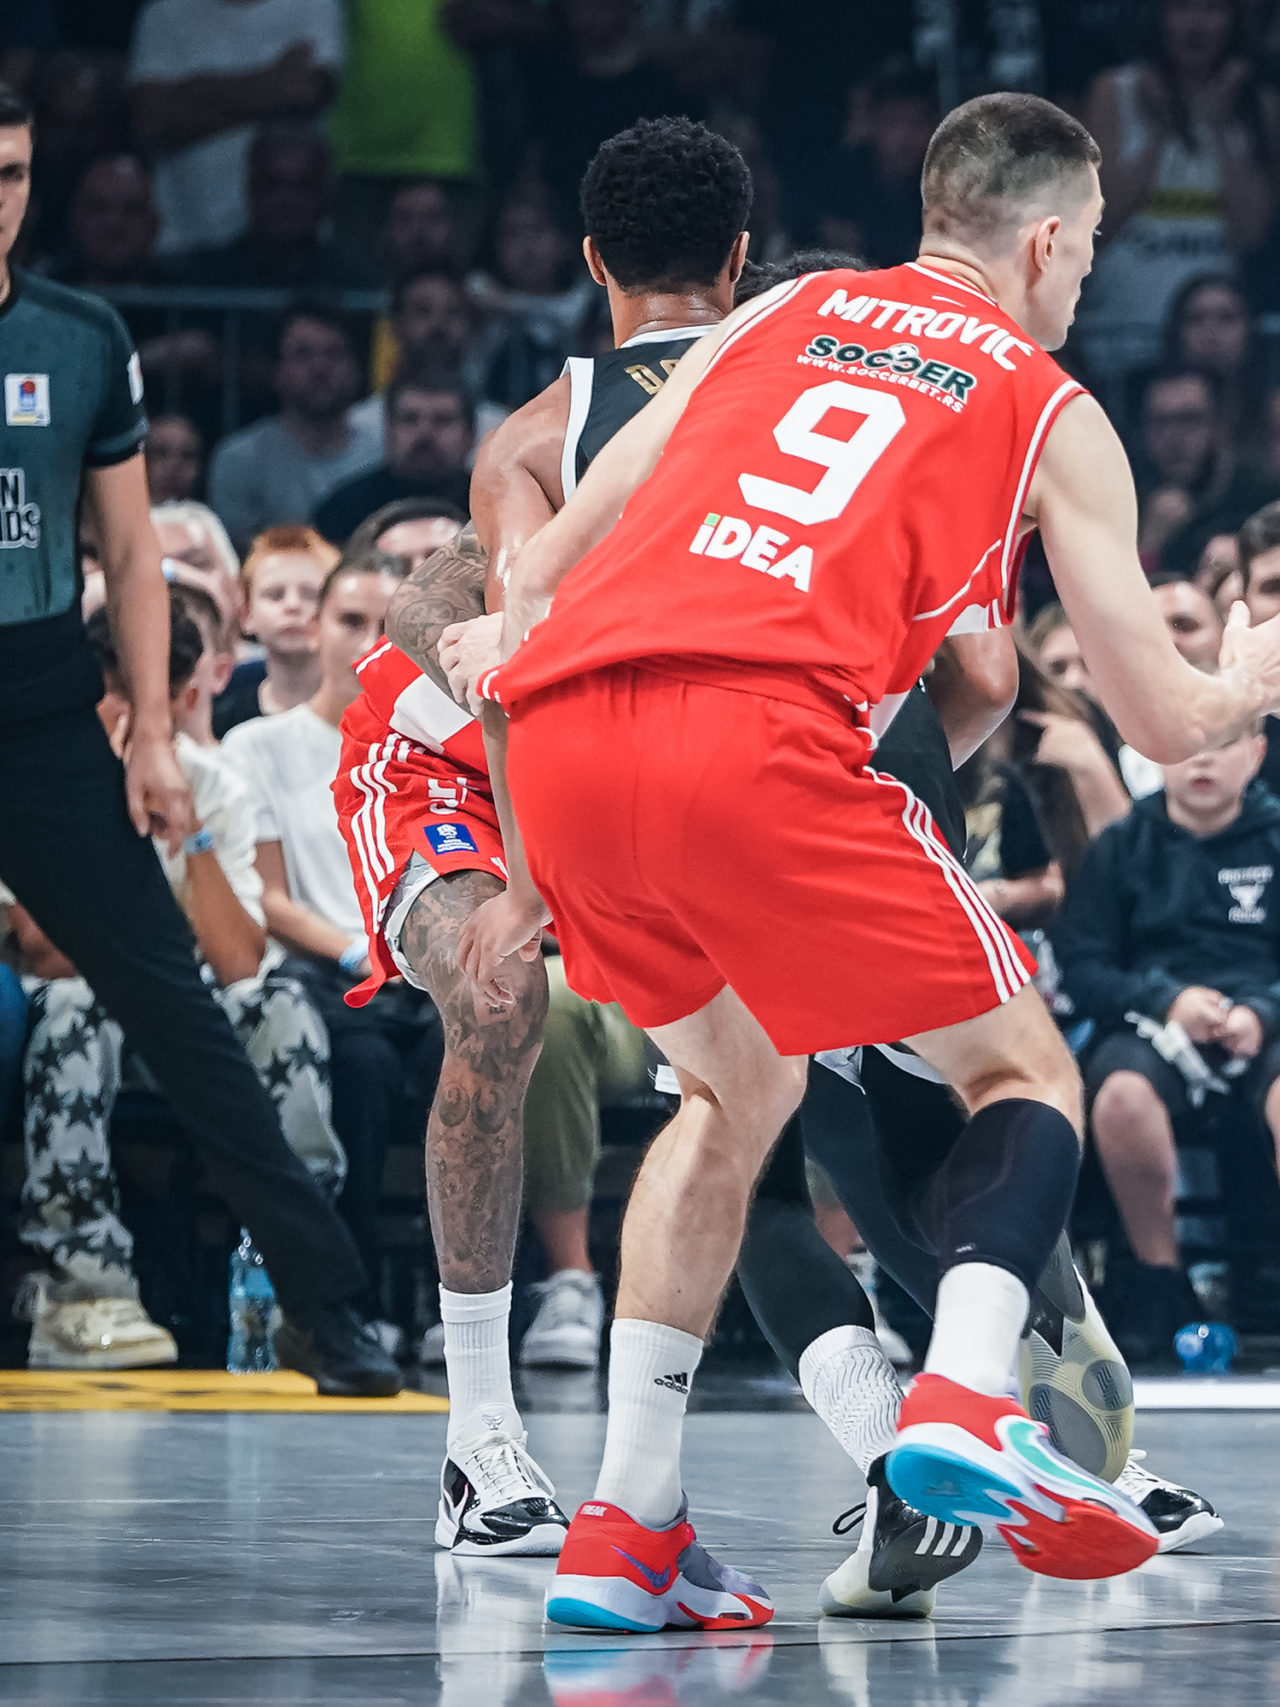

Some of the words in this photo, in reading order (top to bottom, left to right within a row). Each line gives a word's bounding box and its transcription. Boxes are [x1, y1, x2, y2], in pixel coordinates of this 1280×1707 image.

[817, 289, 1035, 371] MITROVIC
[805, 334, 977, 404] SOCCER
[738, 380, 906, 525] 9
[654, 1378, 689, 1395] adida
